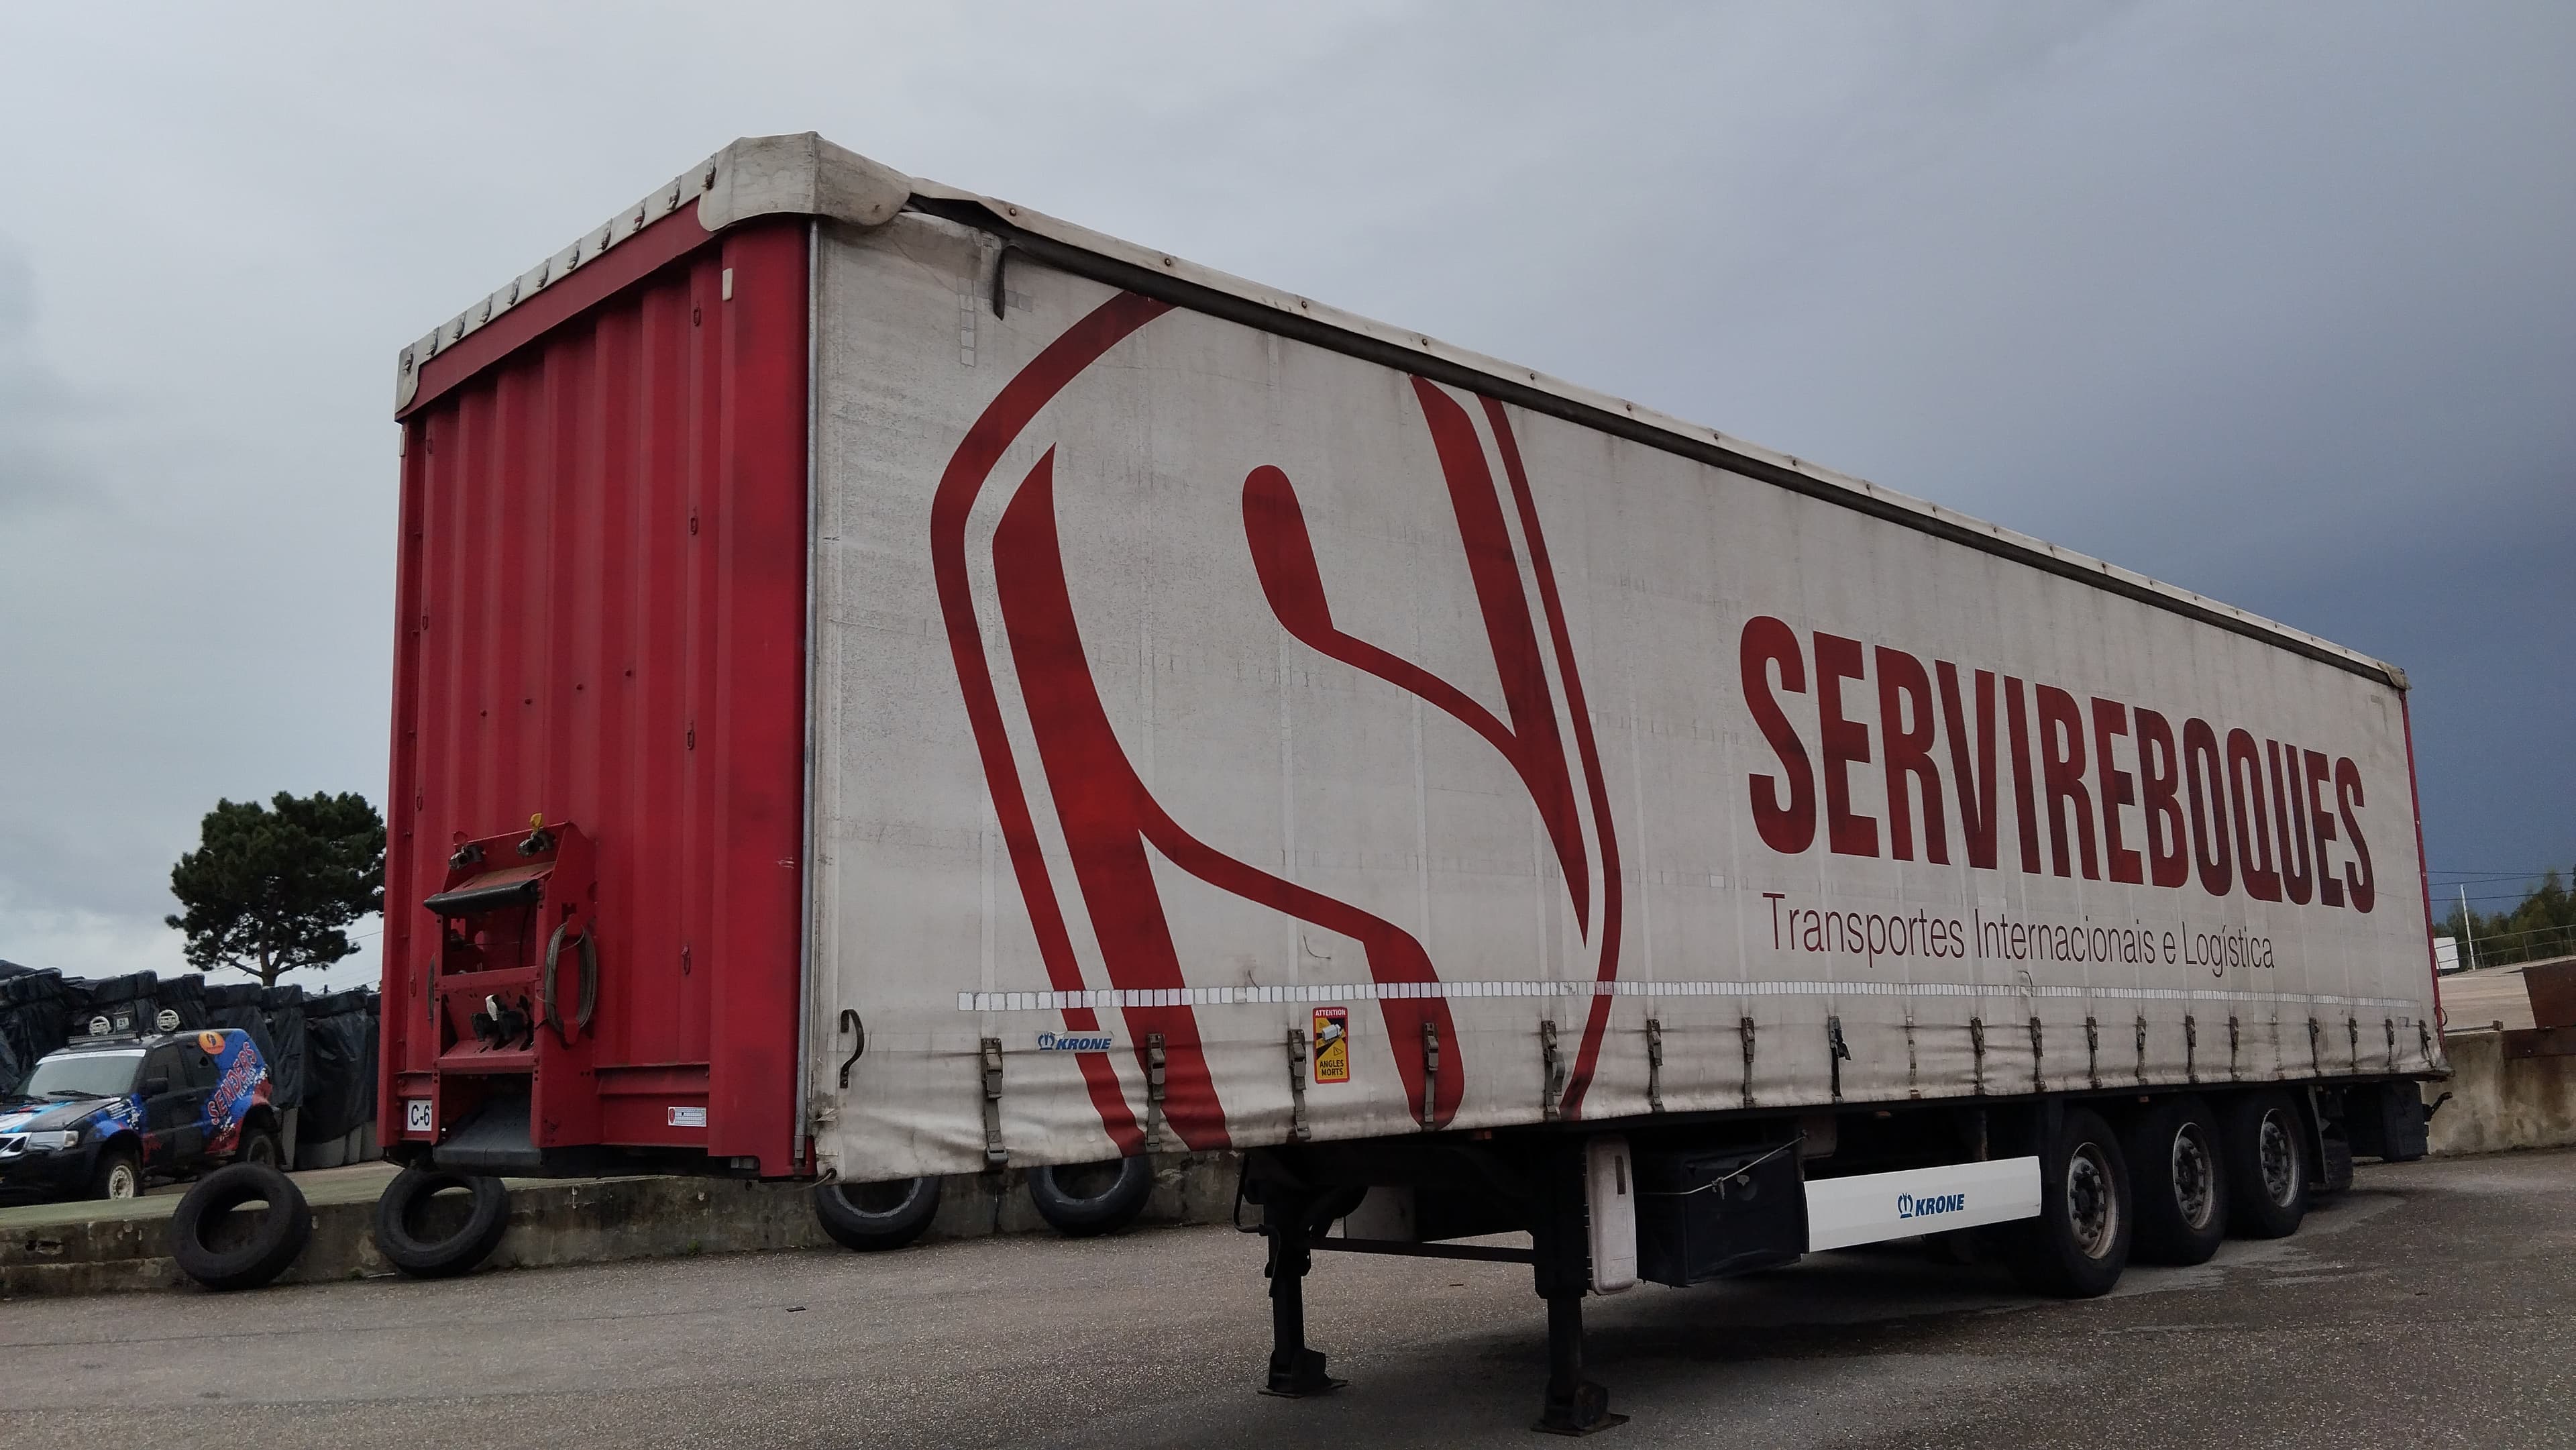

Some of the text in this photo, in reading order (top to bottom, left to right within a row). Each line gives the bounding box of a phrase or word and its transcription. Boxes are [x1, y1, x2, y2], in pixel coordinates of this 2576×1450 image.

[1740, 615, 2375, 914] SERVIREBOQUES
[1762, 892, 2275, 978] Transportes Internacionais e Logística
[1315, 1008, 1346, 1017] ATTENTION
[1056, 1038, 1112, 1050] KRONE
[1320, 1059, 1344, 1068] ANGLES
[1321, 1068, 1344, 1076] MORTS
[208, 1041, 257, 1125] SENDERS
[411, 1104, 432, 1126] C-6
[1915, 1194, 1965, 1216] KRONE
